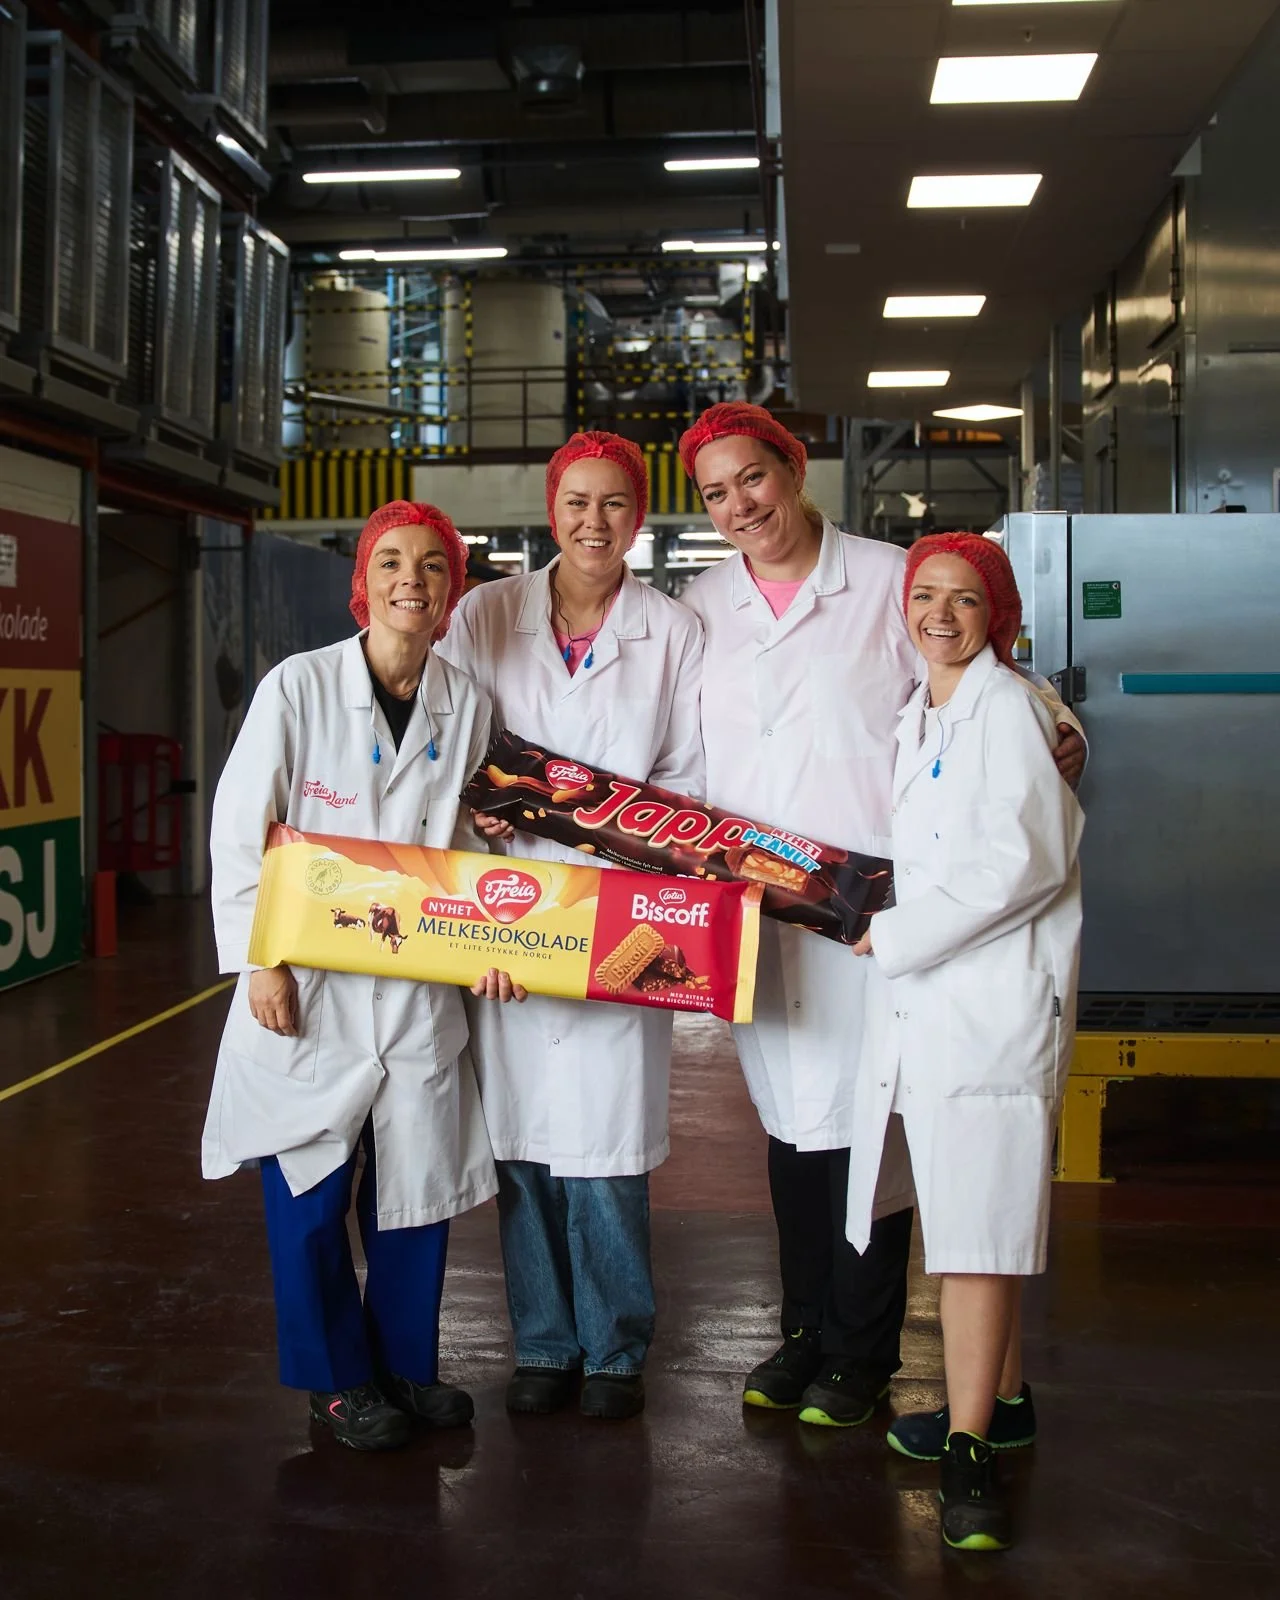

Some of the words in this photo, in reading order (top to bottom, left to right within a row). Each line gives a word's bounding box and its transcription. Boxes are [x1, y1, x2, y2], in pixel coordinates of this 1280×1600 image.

[0, 688, 54, 810] K
[549, 765, 588, 783] Freia
[303, 780, 332, 799] Freia
[325, 791, 358, 808] Land
[573, 781, 756, 850] Japp
[741, 828, 821, 873] PEANUT
[772, 828, 822, 859] NYHET
[484, 874, 536, 908] Freia
[663, 890, 683, 900] Lotus
[428, 901, 474, 917] NYHET
[416, 916, 589, 953] MELKESJOKOLADE
[463, 944, 482, 952] LITE
[486, 946, 518, 956] STYKKE
[522, 951, 553, 960] NORGE
[611, 940, 649, 980] Biscoff
